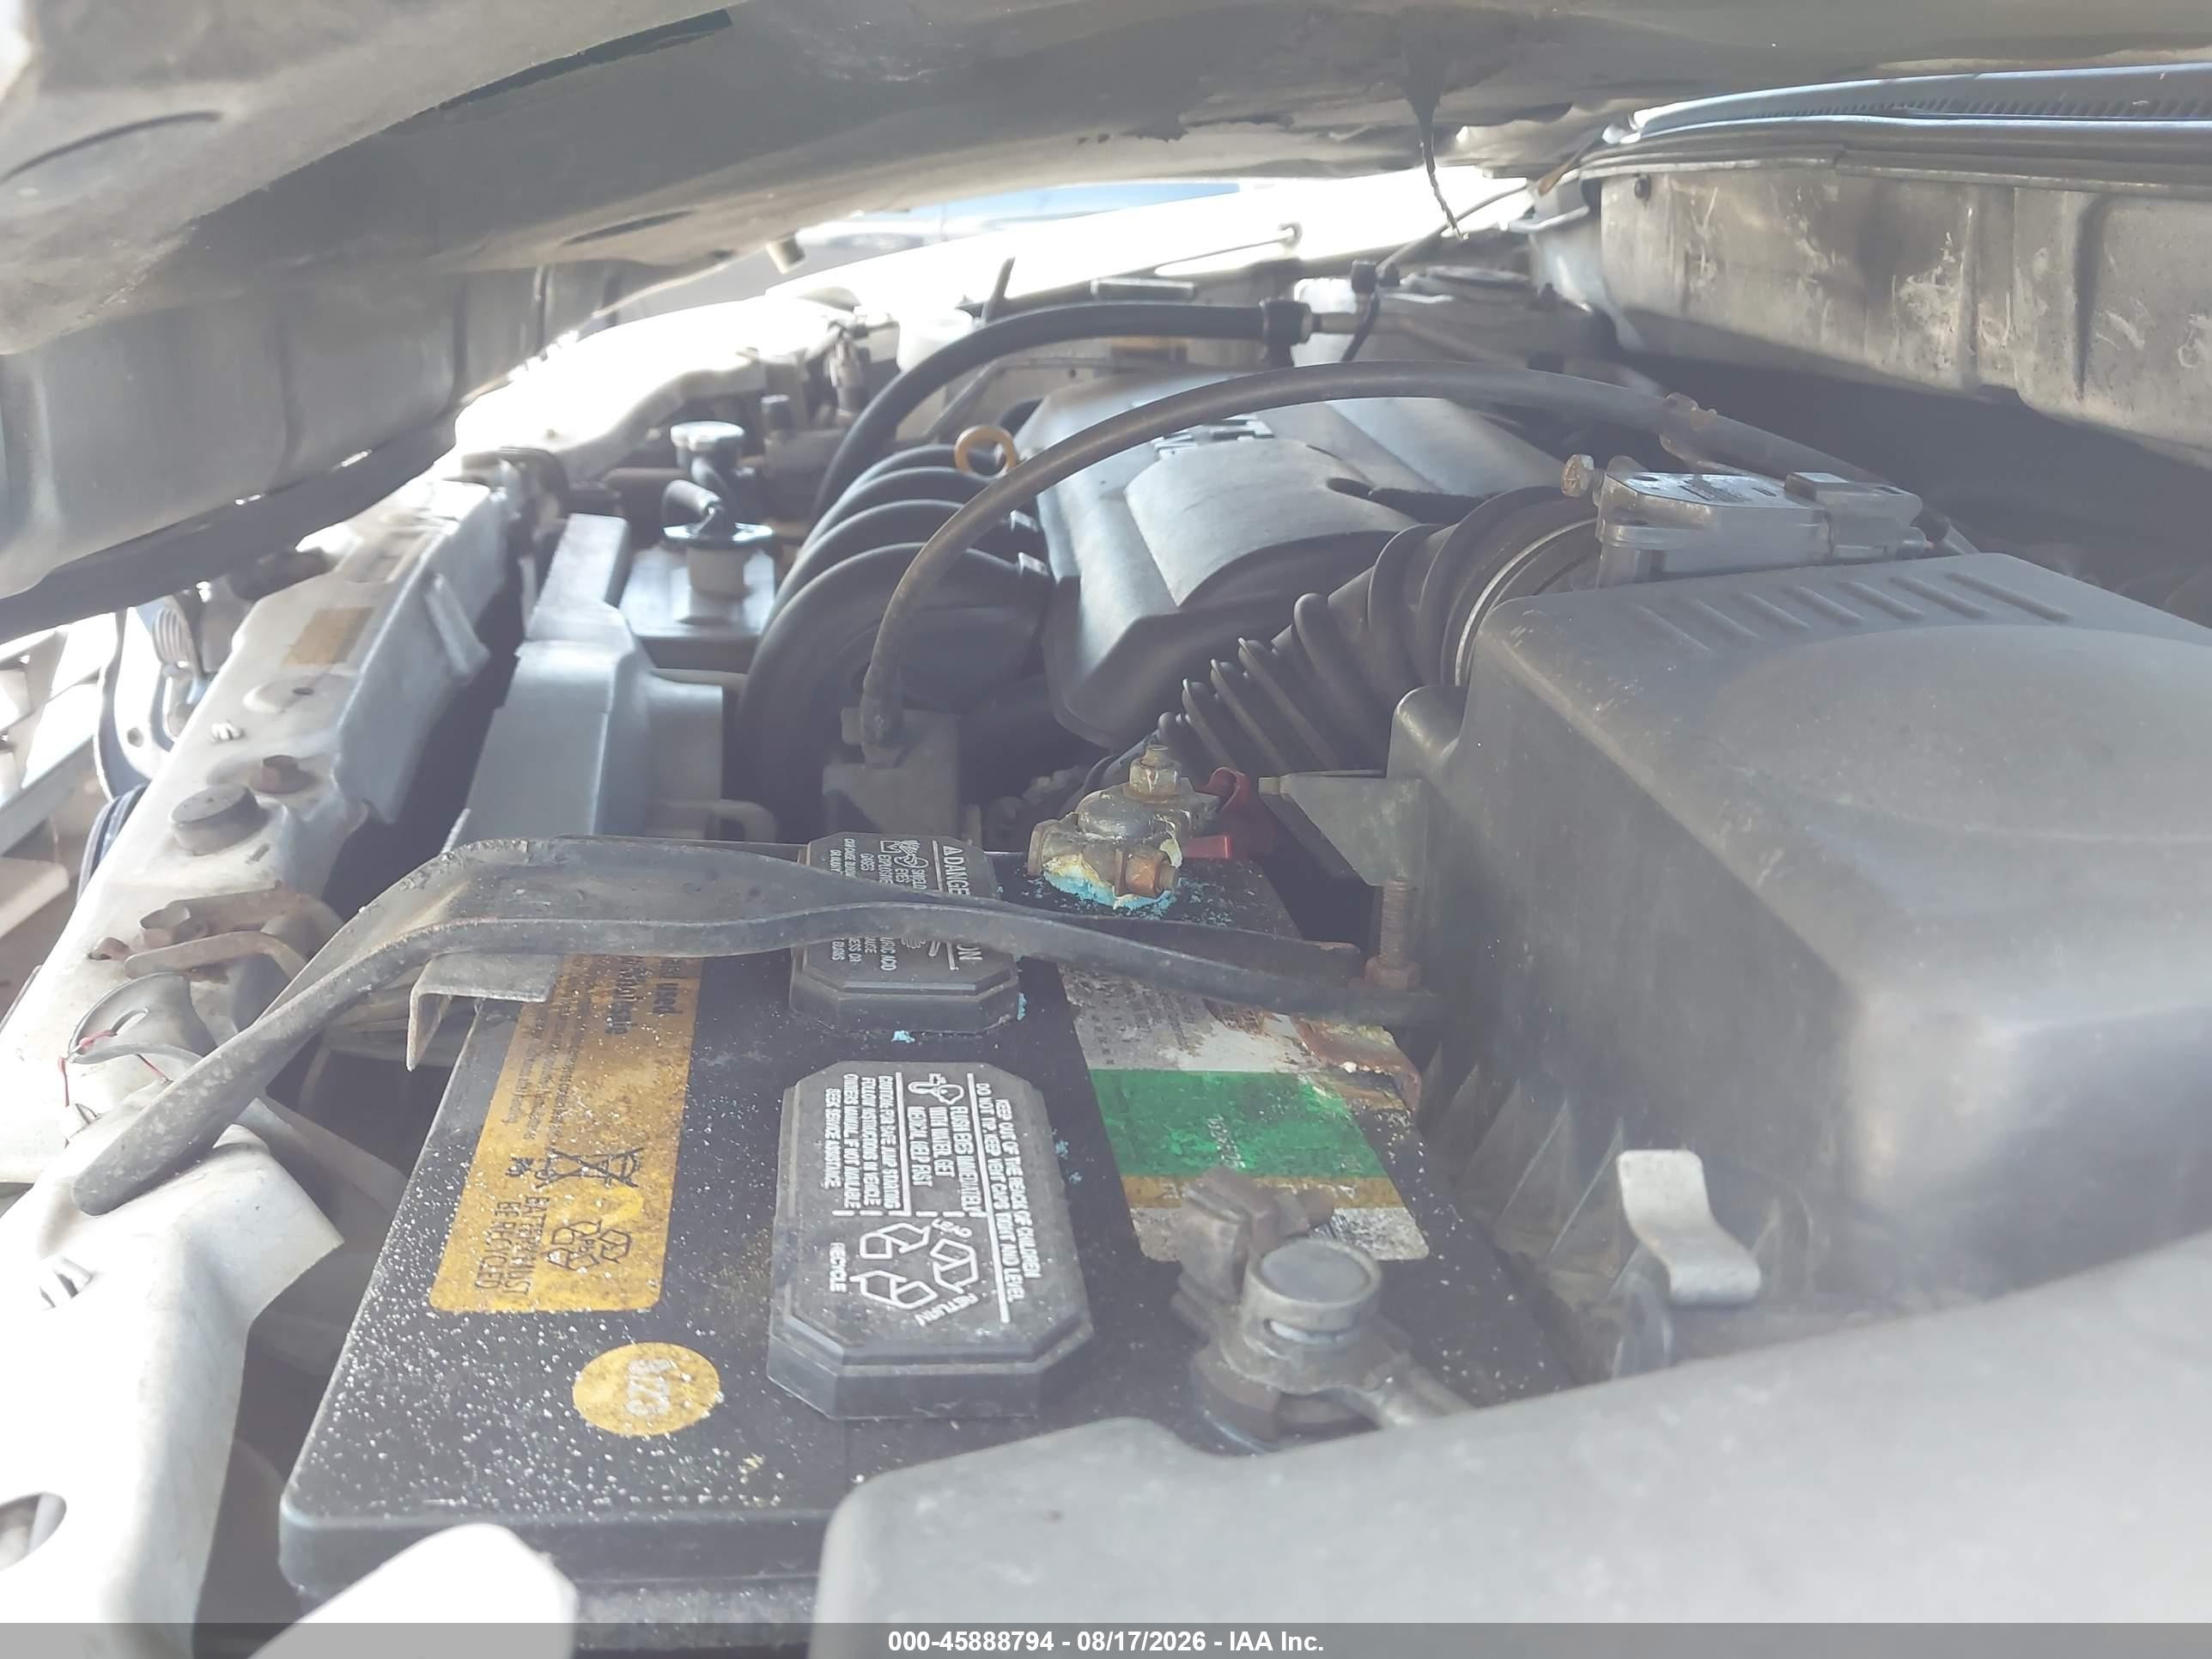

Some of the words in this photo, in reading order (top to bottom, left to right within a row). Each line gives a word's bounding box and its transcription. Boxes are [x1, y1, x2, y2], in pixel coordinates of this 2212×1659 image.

[845, 848, 855, 860] CAUSE
[860, 854, 875, 871] GASES
[878, 854, 894, 884] EXPLOSIVE
[895, 868, 909, 883] EYES
[944, 857, 969, 895] DANGE
[832, 942, 845, 960] BURNS
[879, 937, 896, 953] URIC
[848, 953, 861, 962] OR
[881, 955, 896, 970] ACID
[826, 1089, 841, 1107] SEEK
[861, 1078, 876, 1107] FOLLOW
[976, 1084, 991, 1096] DO
[880, 1109, 895, 1124] FOR
[929, 1107, 948, 1127] WITH
[979, 1097, 994, 1115] NOT
[996, 1099, 1012, 1121] KEEP
[825, 1109, 841, 1139] SERVICE
[908, 1107, 927, 1139] MEDICAL
[951, 1107, 969, 1131] FLUSH
[861, 1108, 878, 1159] INSTRUCTIONS
[880, 1126, 896, 1145] SAFE
[999, 1122, 1016, 1139] OUT
[844, 1139, 860, 1147] IF
[910, 1141, 929, 1163] HELP
[953, 1133, 974, 1154] EYES
[985, 1134, 1000, 1156] KEEP
[1002, 1141, 1019, 1154] OF
[844, 1148, 860, 1165] NOT
[863, 1162, 878, 1170] IN
[881, 1146, 897, 1167] JUMP
[934, 1159, 955, 1176] GET
[1005, 1157, 1023, 1176] THE
[912, 1164, 932, 1186] FAST
[988, 1158, 1006, 1184] VENT
[844, 1166, 860, 1208] AVAILABLE
[864, 1172, 880, 1206] VEHICLE
[883, 1169, 900, 1208] STARTING
[957, 1156, 981, 1212] IMMEDIATELY
[1009, 1177, 1028, 1212] REACH
[992, 1183, 1010, 1209] CAPS
[493, 1201, 522, 1217] BE
[1014, 1211, 1032, 1225] OF
[510, 1196, 551, 1252] BATTERY
[996, 1212, 1015, 1242] TIGHT
[471, 1221, 518, 1290] RECYCLED
[1000, 1244, 1018, 1266] AND
[1018, 1227, 1041, 1277] CHILDREN
[501, 1256, 537, 1295] MUST
[830, 1243, 847, 1291] RECYCLE
[915, 1292, 979, 1327] RETURN
